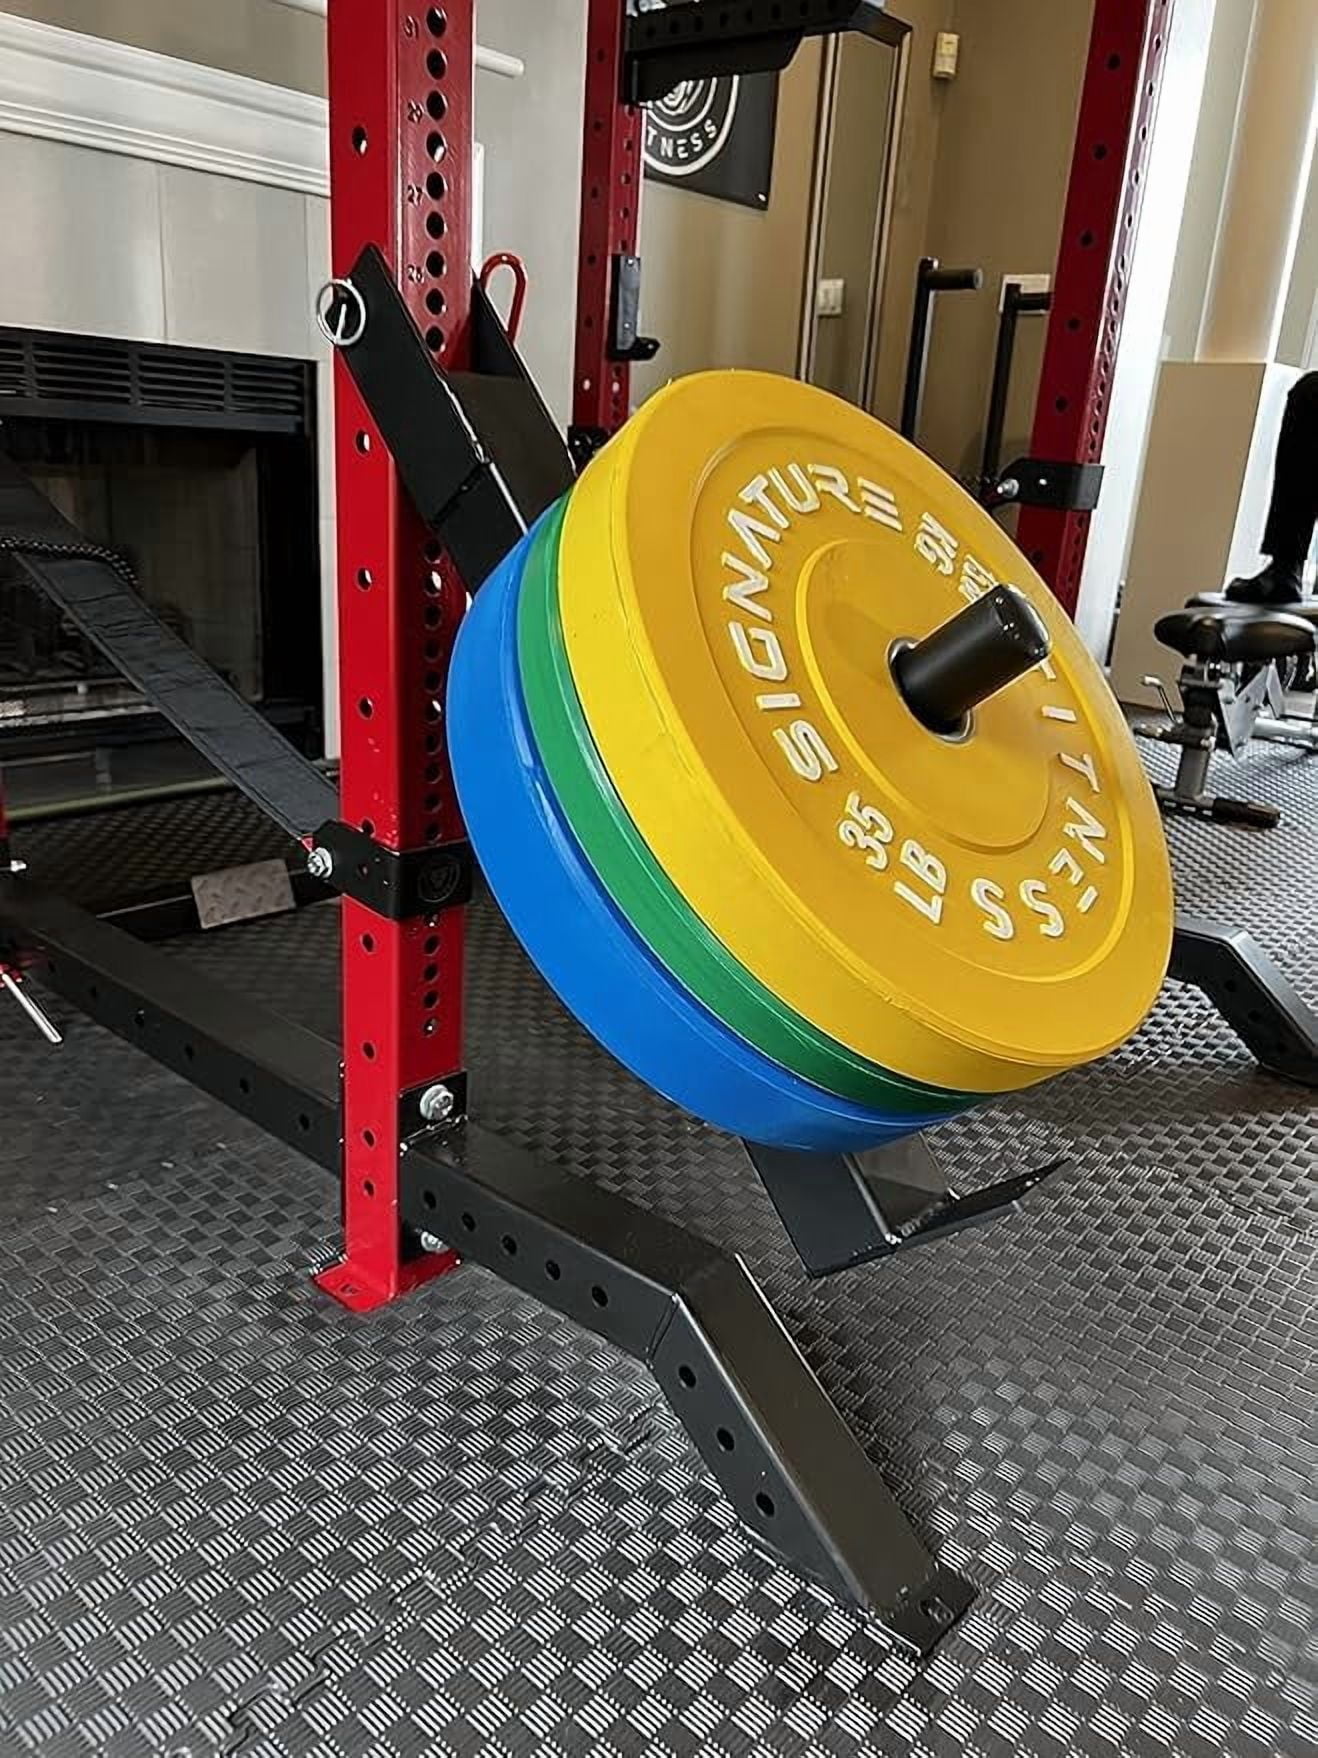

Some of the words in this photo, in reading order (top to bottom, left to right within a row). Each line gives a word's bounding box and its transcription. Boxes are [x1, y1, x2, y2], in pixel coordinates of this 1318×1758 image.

[647, 119, 718, 159] TNESS
[721, 463, 903, 782] SIGNATURE
[837, 791, 894, 871] 35
[894, 838, 948, 924] LB
